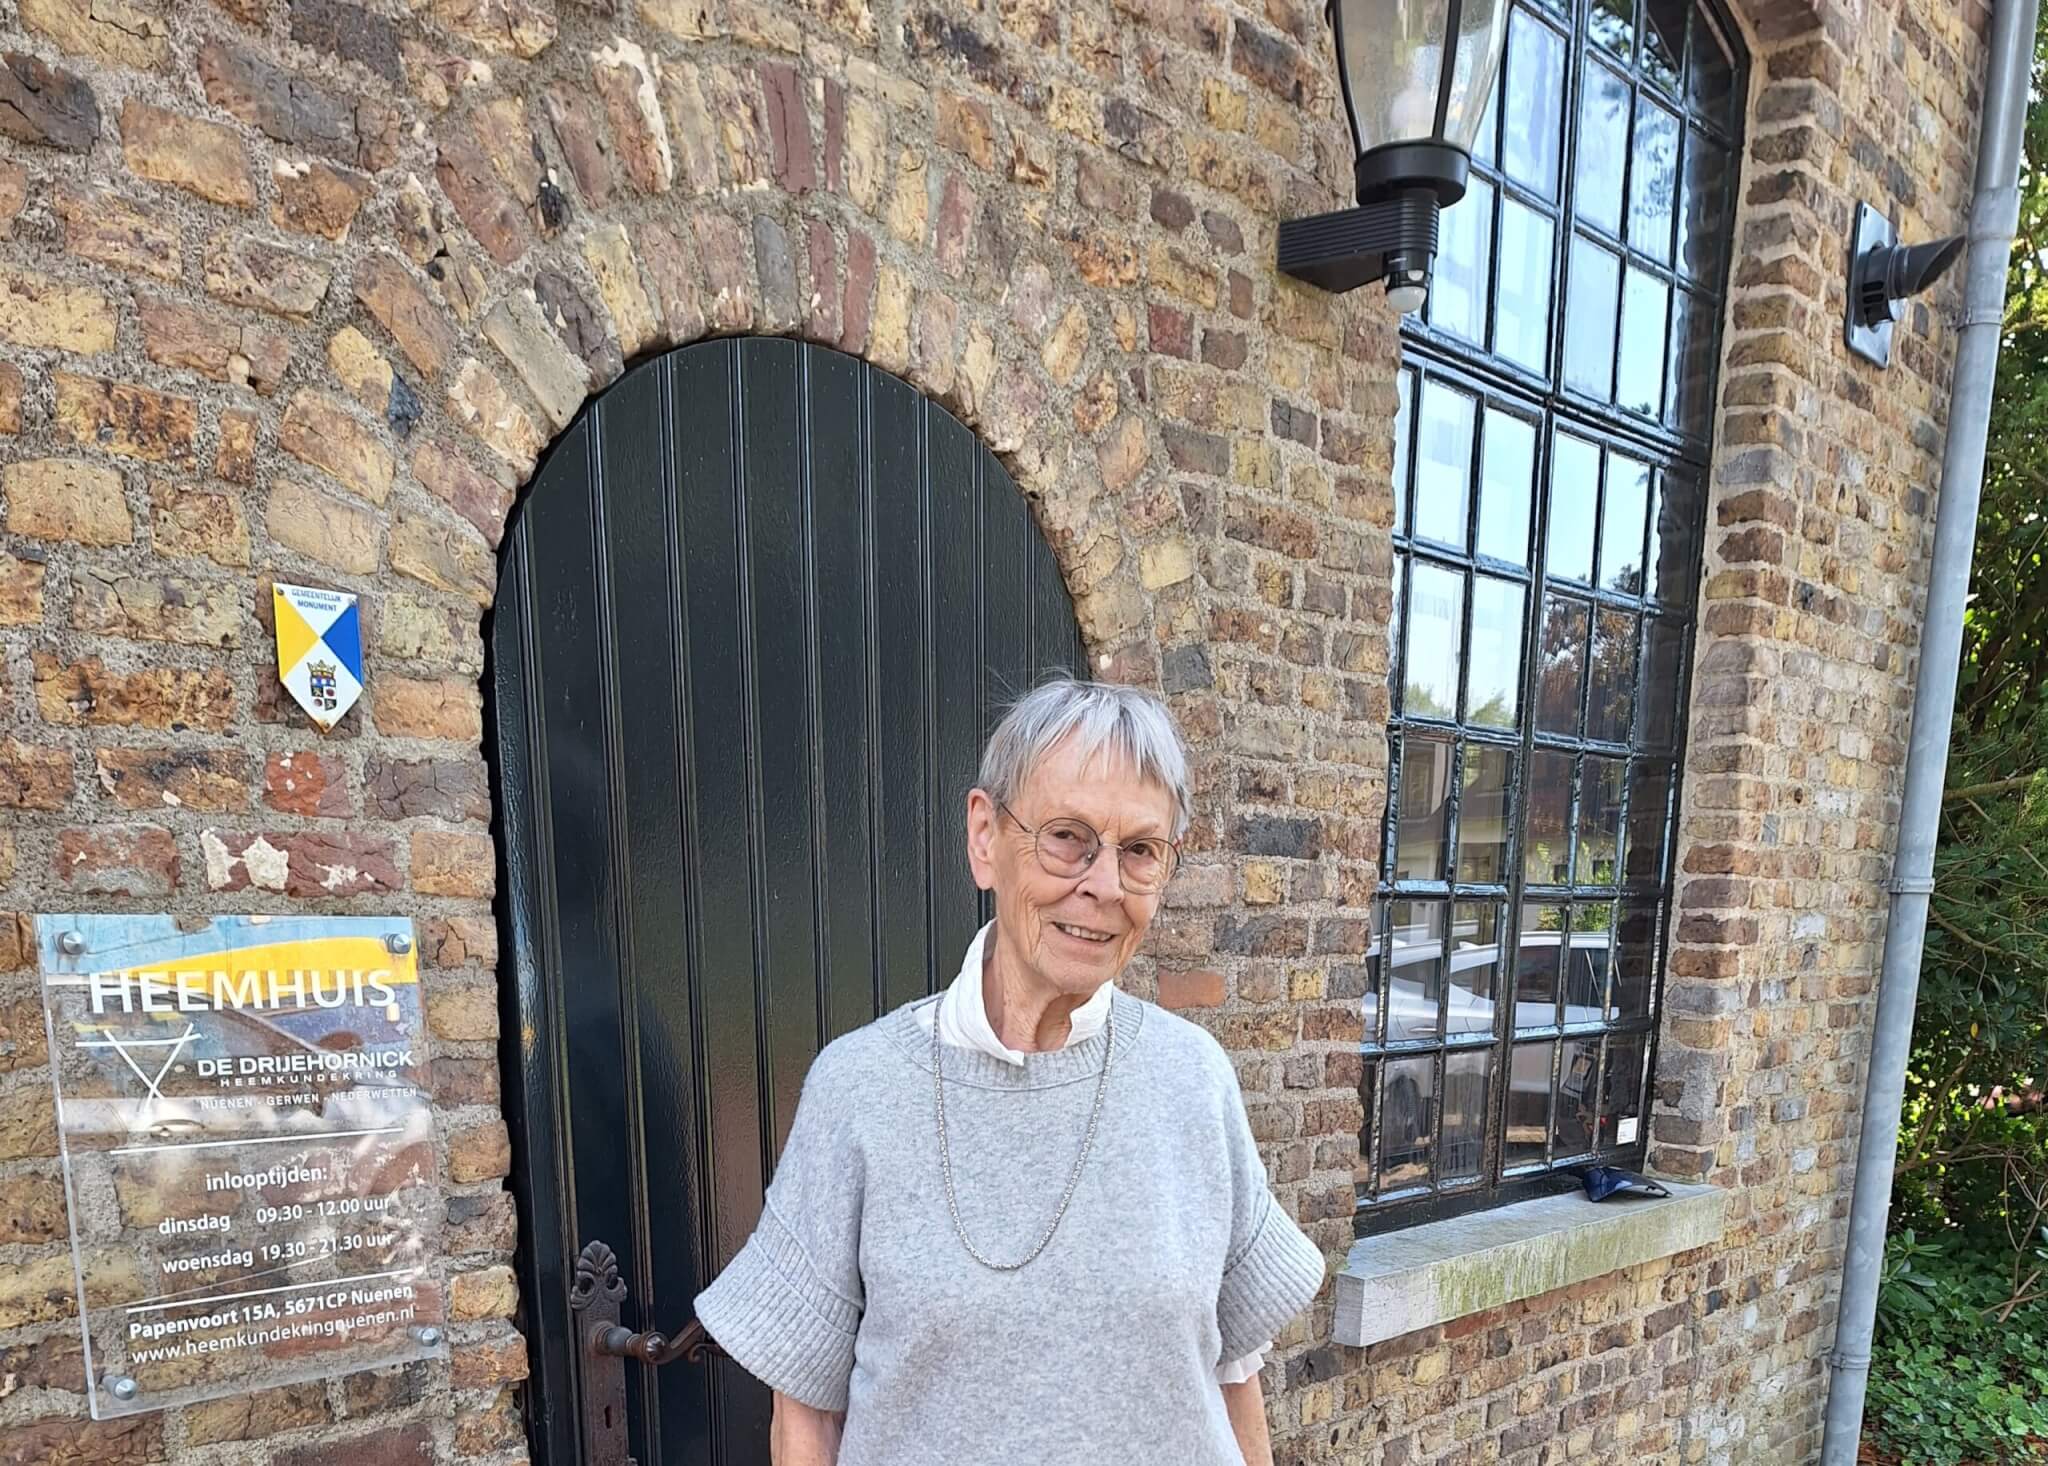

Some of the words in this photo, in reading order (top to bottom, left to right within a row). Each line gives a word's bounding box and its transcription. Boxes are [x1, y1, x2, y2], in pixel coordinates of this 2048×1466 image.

[297, 600, 337, 611] MONUMENT
[88, 968, 397, 1014] HEEMHUIS
[198, 1058, 234, 1076] DE
[239, 1051, 414, 1074] DRIJEHORNICK
[220, 1070, 398, 1088] HEEMKUNDEKRING
[200, 1097, 253, 1111] NUENEN
[266, 1094, 320, 1107] GERWEN
[331, 1087, 418, 1102] NEDERWETTEN
[205, 1166, 328, 1193] inlooptijden:
[158, 1212, 232, 1236] dinsdag
[256, 1204, 303, 1224] 09.30
[317, 1198, 361, 1218] 12.00
[364, 1197, 391, 1213] uur
[162, 1247, 254, 1274] woensdag
[260, 1242, 306, 1262] 19.30
[319, 1234, 363, 1254] 21.30
[366, 1233, 393, 1249] uur
[129, 1309, 239, 1340] Papenvoort
[242, 1303, 281, 1323] 15A,
[285, 1292, 348, 1316] 5671CP
[351, 1284, 414, 1305] Nuenen
[132, 1306, 415, 1363] www.heemkundekringnuenen.nl
